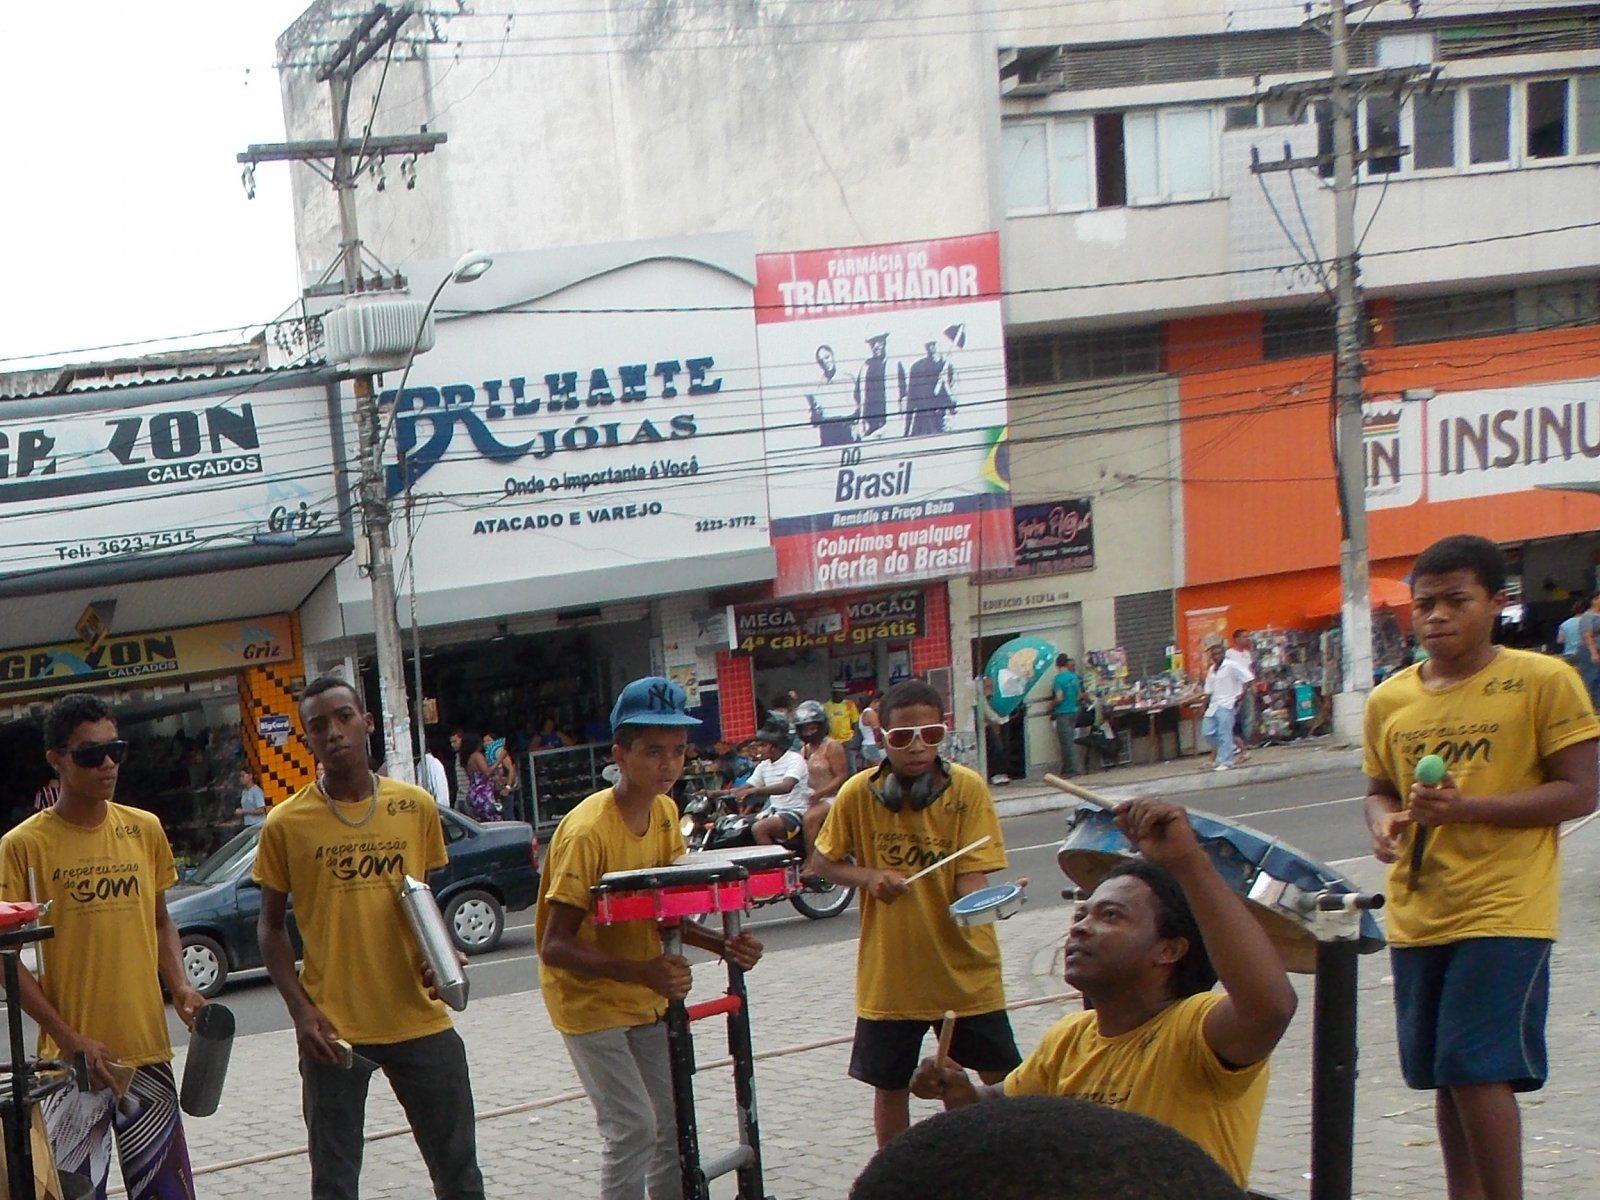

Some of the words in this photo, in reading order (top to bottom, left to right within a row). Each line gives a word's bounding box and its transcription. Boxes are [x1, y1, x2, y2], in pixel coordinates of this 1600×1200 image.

[828, 252, 903, 278] FARMÁCIA
[907, 251, 928, 270] DO
[778, 264, 979, 317] TRABALHADOR
[380, 356, 723, 497] BRILHANTE
[532, 413, 699, 460] JÓIAS
[147, 456, 260, 484] CALÇADOS
[504, 475, 545, 497] Onde
[549, 478, 560, 492] o
[660, 455, 699, 477] Você
[835, 461, 912, 503] Brasil
[268, 501, 324, 535] Griz
[473, 513, 563, 535] ATACADO
[570, 510, 580, 526] E
[588, 501, 663, 524] VAREJO
[832, 511, 879, 529] Remédio
[882, 512, 890, 522] a
[891, 504, 921, 521] Preço
[924, 500, 955, 517] Baixo
[55, 545, 92, 563] Tel:
[97, 529, 198, 557] 3623-7515
[816, 533, 893, 559] Cobrimos
[898, 523, 972, 552] qualquer
[817, 554, 879, 586] oferta
[884, 550, 908, 574] do
[915, 540, 972, 571] Brasil
[740, 609, 797, 629] MEGA
[852, 619, 917, 644] grátis
[242, 637, 281, 661] Griz
[108, 661, 177, 679] CALÇADOS
